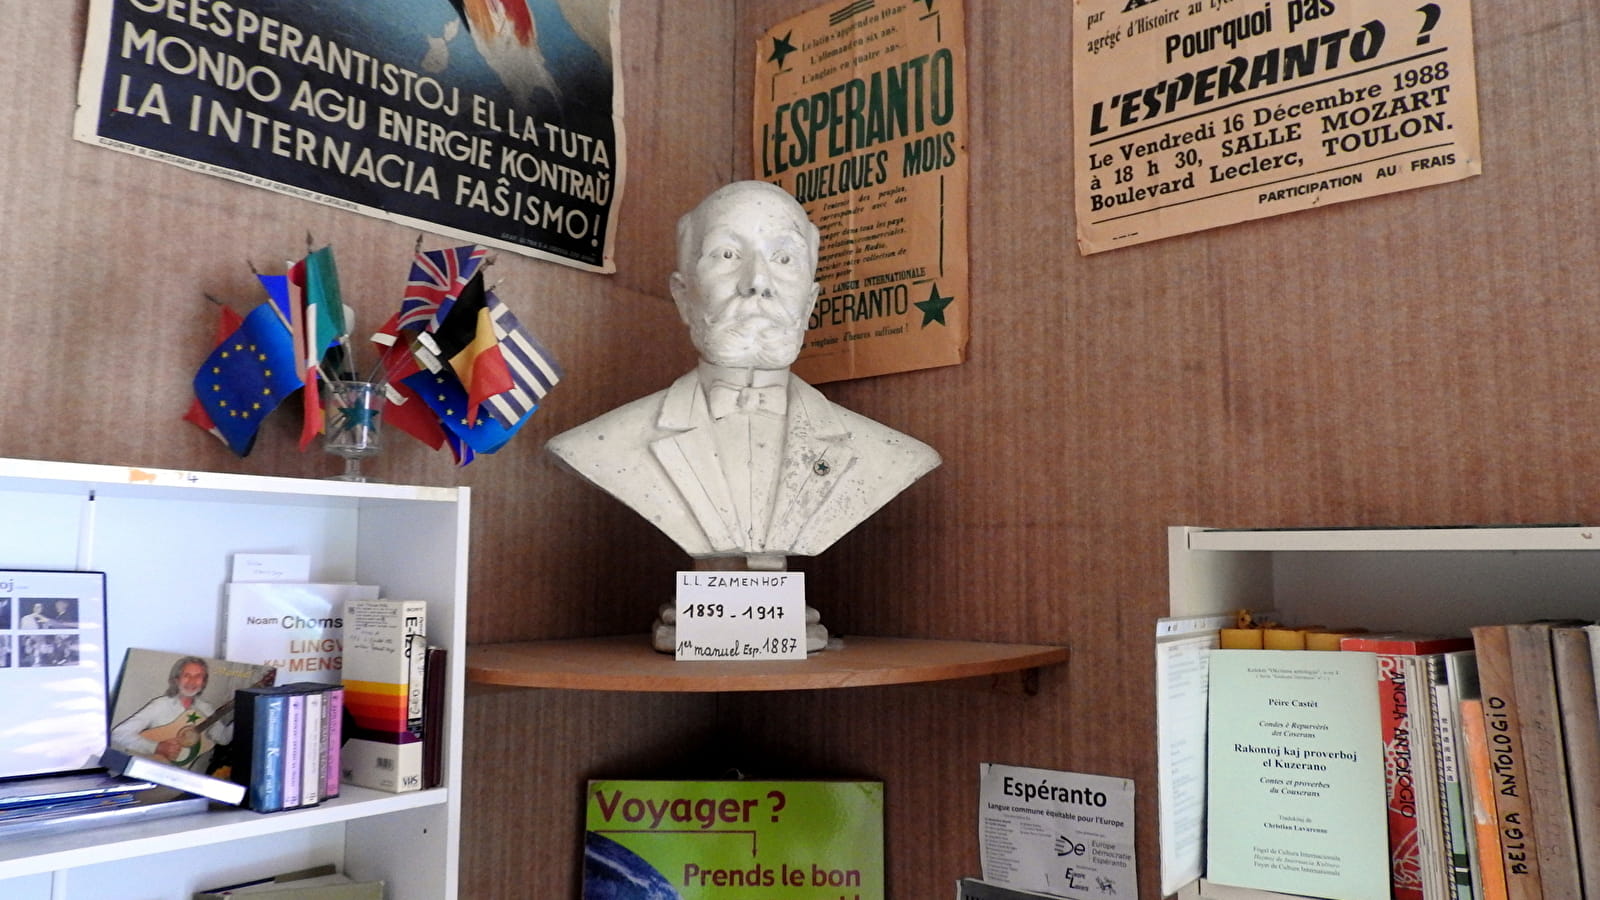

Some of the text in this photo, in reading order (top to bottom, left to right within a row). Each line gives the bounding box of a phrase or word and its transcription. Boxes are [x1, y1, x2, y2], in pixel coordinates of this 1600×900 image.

[1087, 10, 1105, 30] par
[1087, 24, 1121, 54] agrégé
[1127, 9, 1180, 39] d'Histoire
[1188, 1, 1202, 16] au
[1165, 0, 1335, 64] Pourquoi pas
[1089, 3, 1442, 136] L'ESPERANTO ?
[121, 21, 610, 206] MONDO AGU ENERGIE KONTRAŬ
[473, 94, 502, 132] EL
[509, 109, 539, 147] LA
[544, 122, 610, 169] TUTA
[763, 48, 954, 178] L'ESPERANTO
[1089, 61, 1449, 171] Le Vendredi 16 Décembre 1988
[117, 74, 172, 125] LA
[189, 95, 440, 200] INTERNACIA
[1090, 84, 1450, 190] à 18 h 30, SALLE MOZART
[796, 131, 955, 204] QUELQUES MOIS
[1091, 112, 1453, 212] Boulevard Leclerc, TOULON.
[1258, 152, 1456, 204] PARTICIPATION AU FRAIS
[833, 280, 860, 293] LANGUE
[864, 267, 926, 287] INTERNATIONALE
[808, 284, 908, 330] SPERANTO
[708, 576, 788, 587] ZAMENHOF
[247, 616, 279, 625] Noam
[682, 603, 724, 618] 1859
[742, 605, 785, 619] 1917
[694, 640, 740, 657] manuel
[743, 644, 762, 658] Esp.
[763, 637, 798, 654] 1887
[1234, 743, 1357, 762] Rakontoj kaj proverboj
[1391, 671, 1417, 818] ANGLA ANTOLOGIO
[402, 775, 419, 787] VHS
[1260, 776, 1284, 785] Contes
[1294, 779, 1330, 789] proverbes
[1263, 759, 1327, 772] el Kuzerano
[595, 790, 786, 829] Voyager ?
[1003, 776, 1107, 807] Espéranto
[988, 802, 1124, 828] Langue commune équitable pour l'Europe
[1264, 822, 1293, 831] Christian
[1092, 840, 1116, 850] Europe
[1504, 812, 1529, 875] BELGA
[683, 863, 861, 887] Prends le bon
